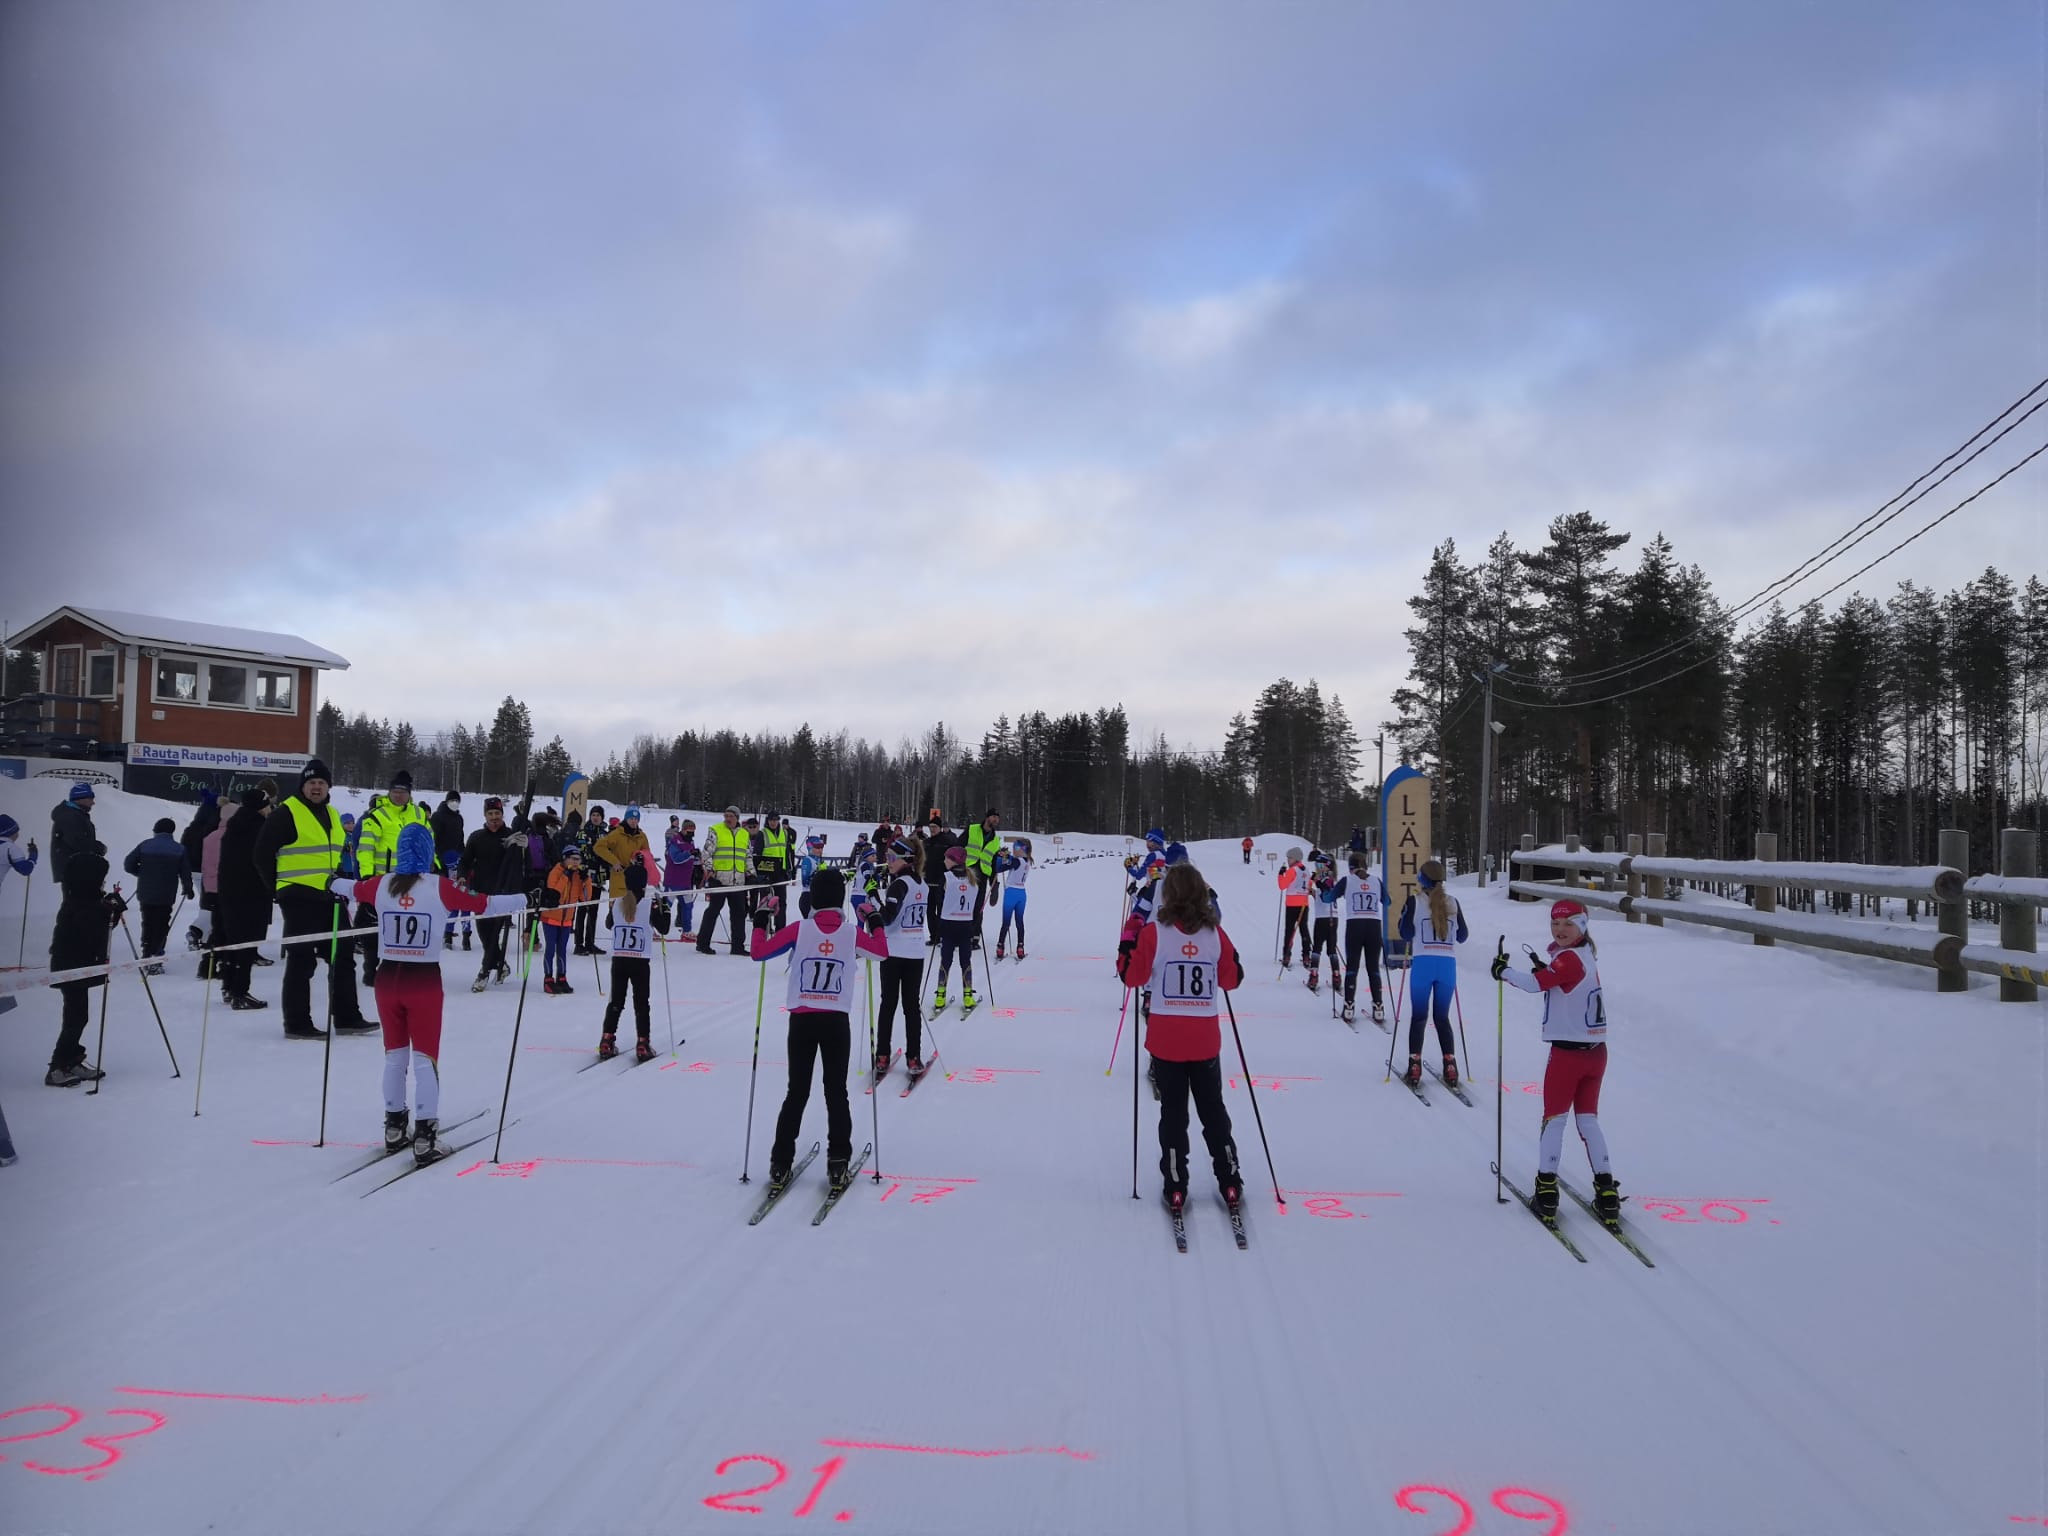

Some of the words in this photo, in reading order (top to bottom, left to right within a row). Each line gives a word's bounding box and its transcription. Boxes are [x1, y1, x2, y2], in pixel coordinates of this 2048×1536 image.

[142, 745, 180, 759] Rauta
[181, 748, 248, 766] Rautapohja
[1398, 794, 1420, 898] LÄHT
[1359, 894, 1373, 910] 12
[394, 915, 418, 945] 19
[621, 928, 637, 949] 15
[811, 961, 836, 991] 17
[1178, 965, 1204, 996] 18
